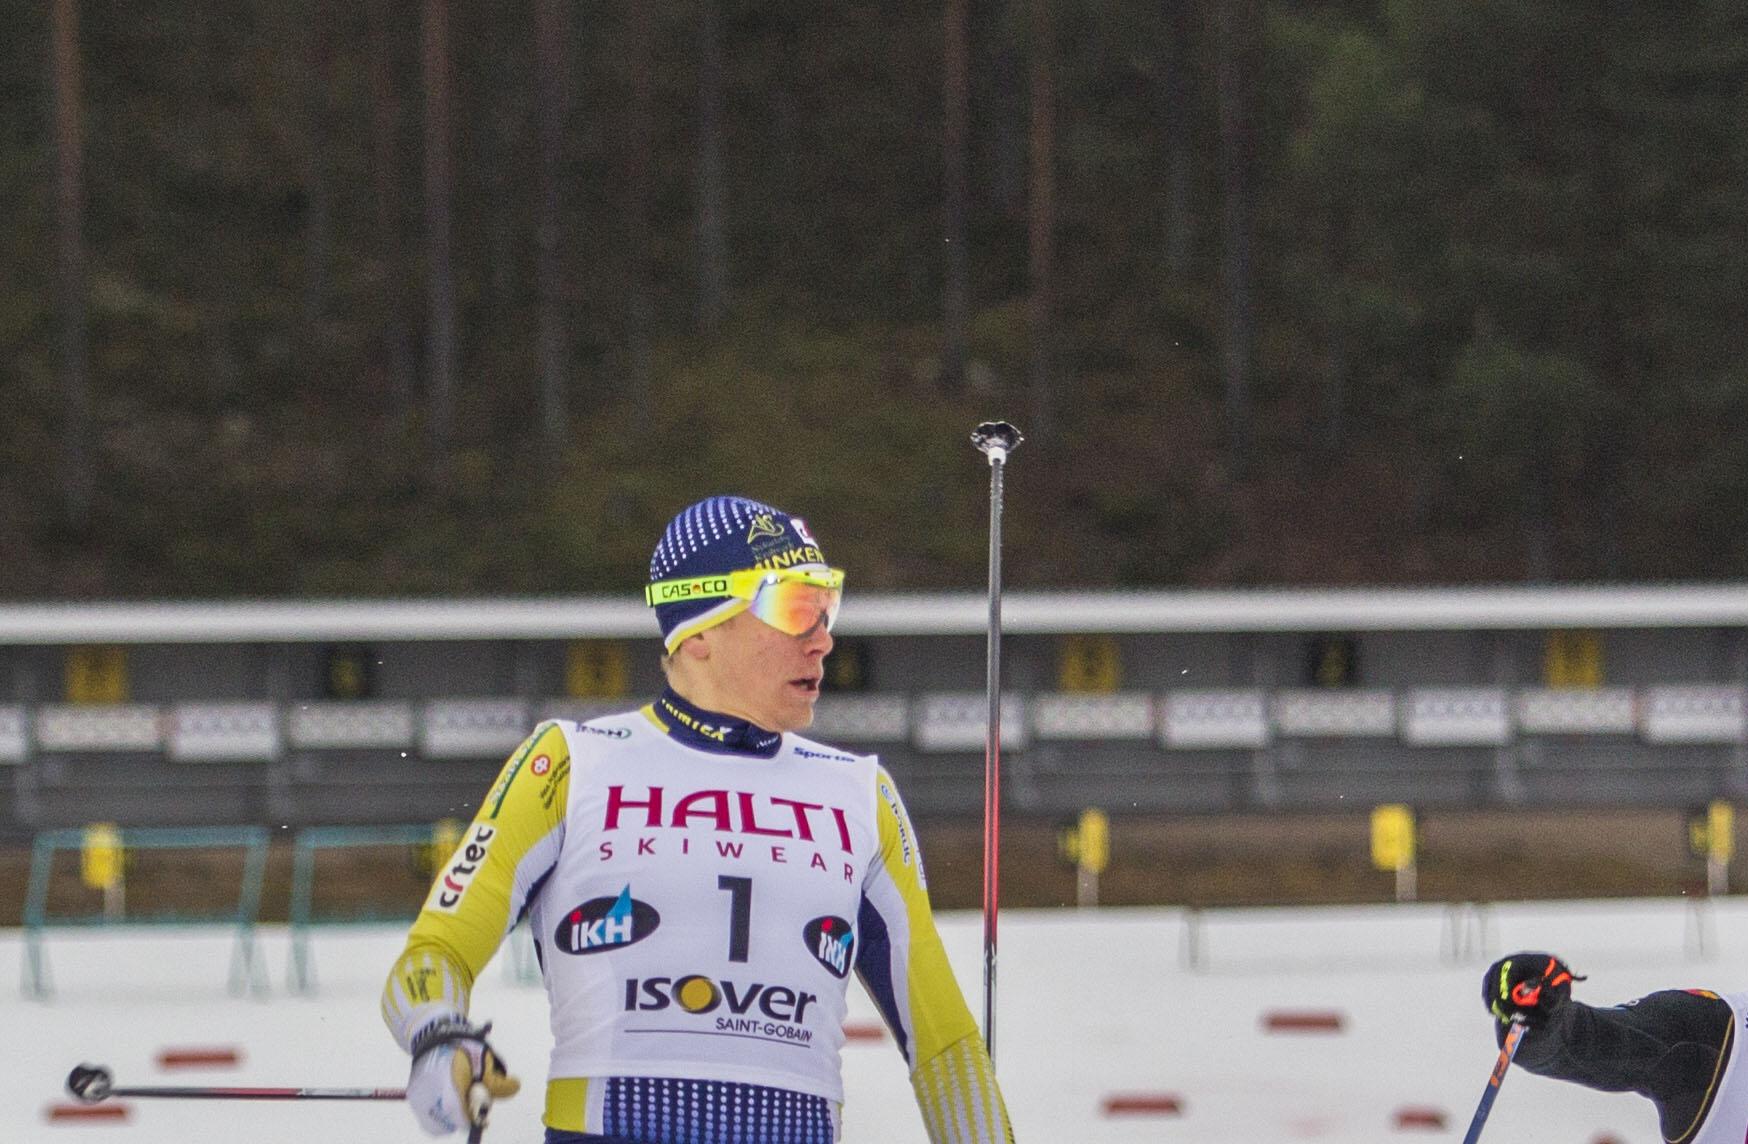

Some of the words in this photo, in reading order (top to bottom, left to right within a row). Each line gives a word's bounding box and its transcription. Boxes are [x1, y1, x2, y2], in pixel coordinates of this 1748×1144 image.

[602, 784, 854, 856] HALTI
[599, 837, 854, 885] SKIWEAR
[717, 874, 753, 964] 1
[716, 1017, 813, 1043] SAINT-GOBAIN
